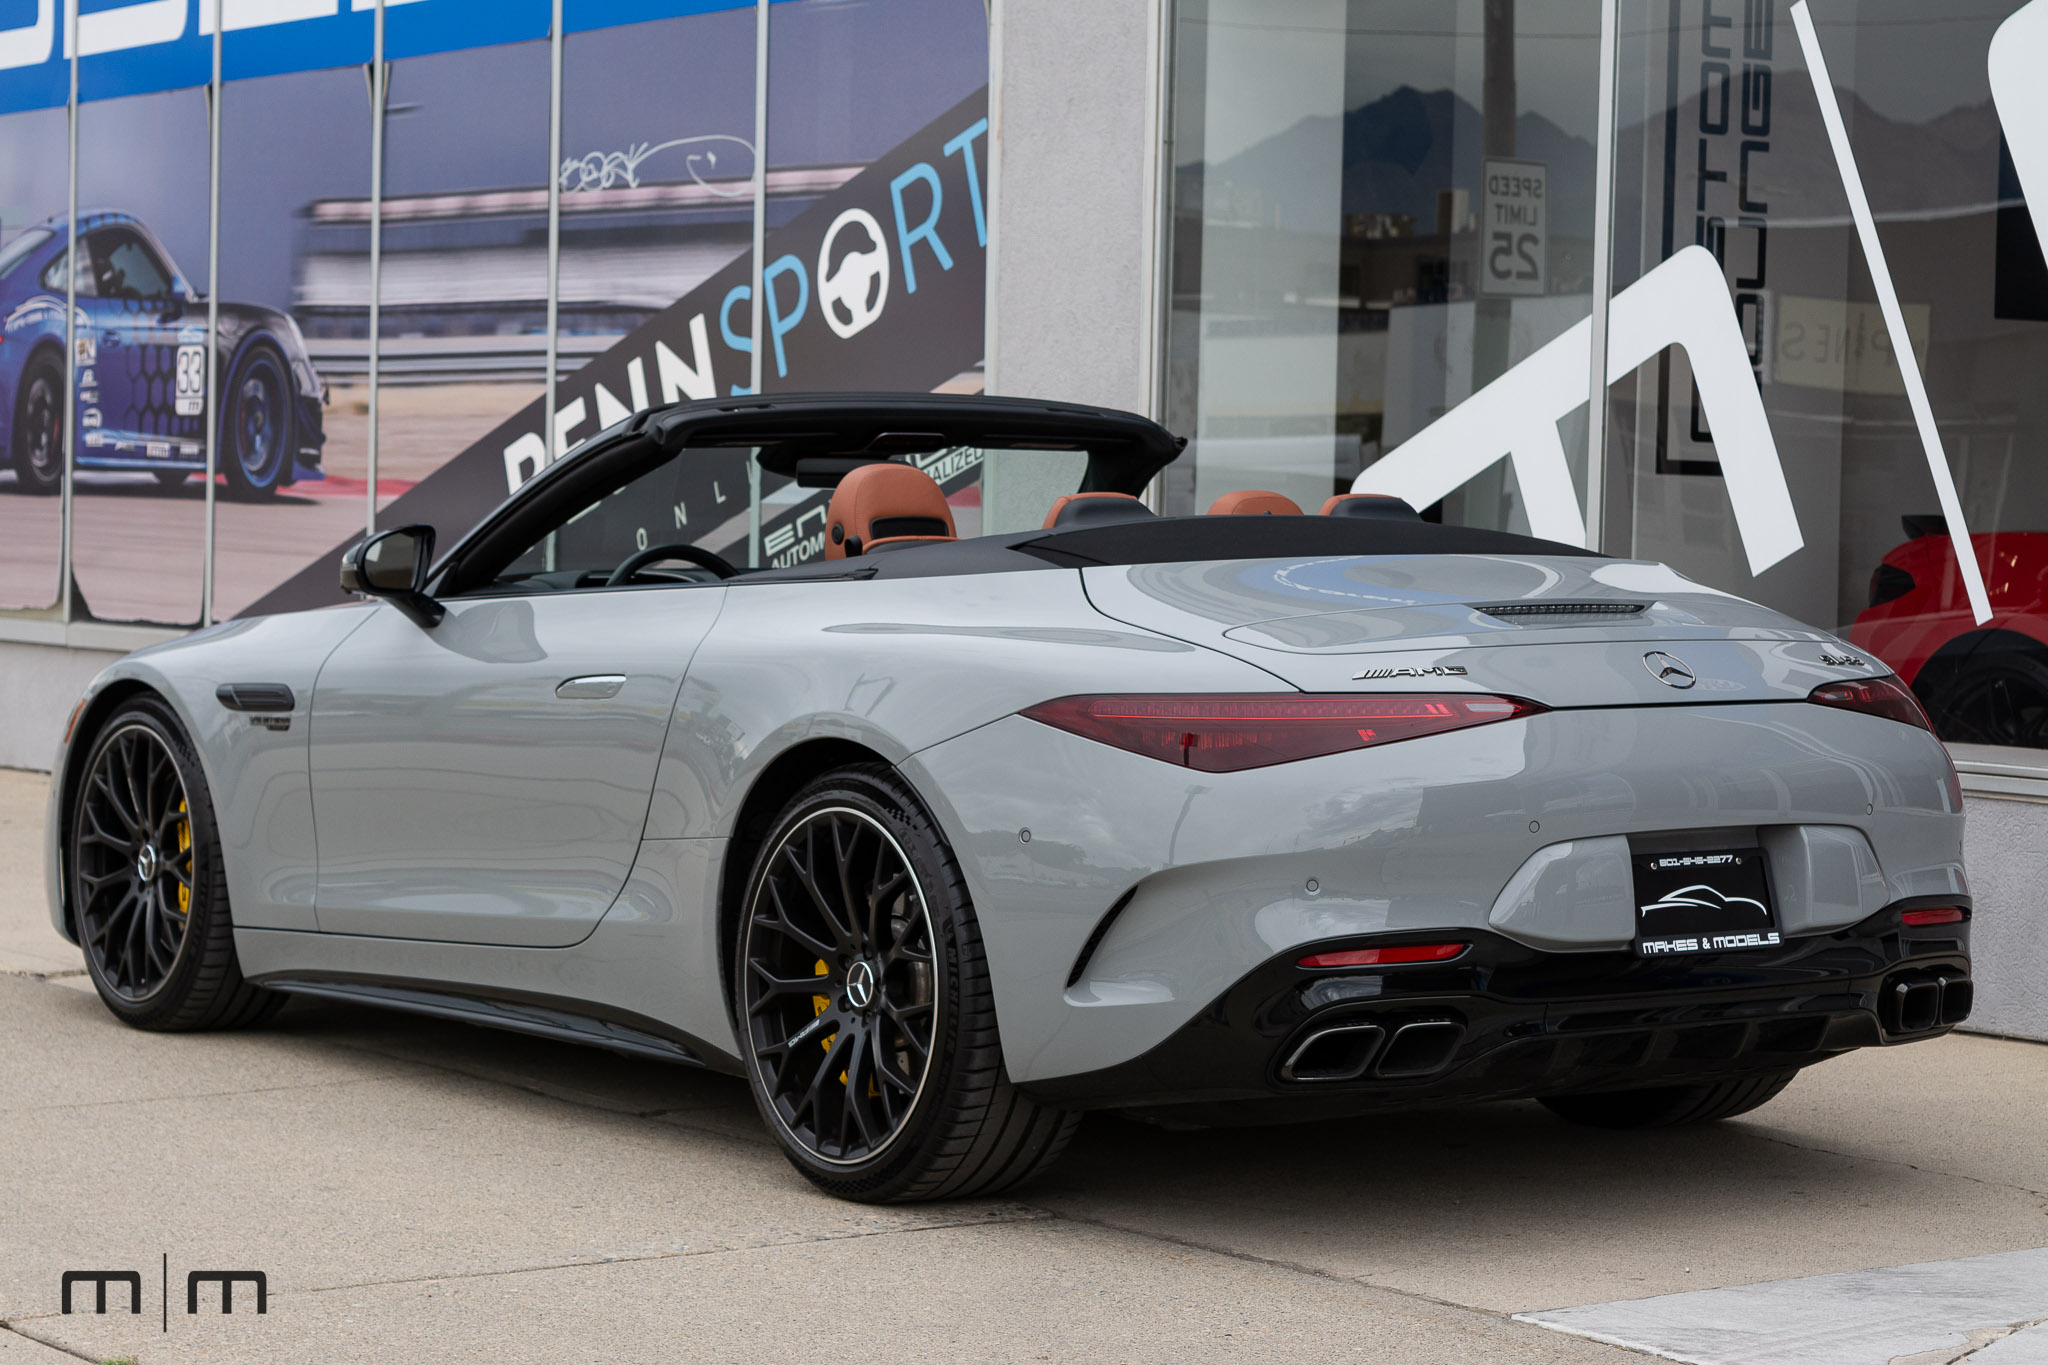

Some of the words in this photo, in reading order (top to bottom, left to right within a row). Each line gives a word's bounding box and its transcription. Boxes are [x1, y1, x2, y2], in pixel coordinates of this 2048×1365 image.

[177, 351, 202, 394] 33
[1642, 938, 1699, 954] MAKES
[1702, 937, 1711, 950] &
[1712, 932, 1781, 949] MODELS
